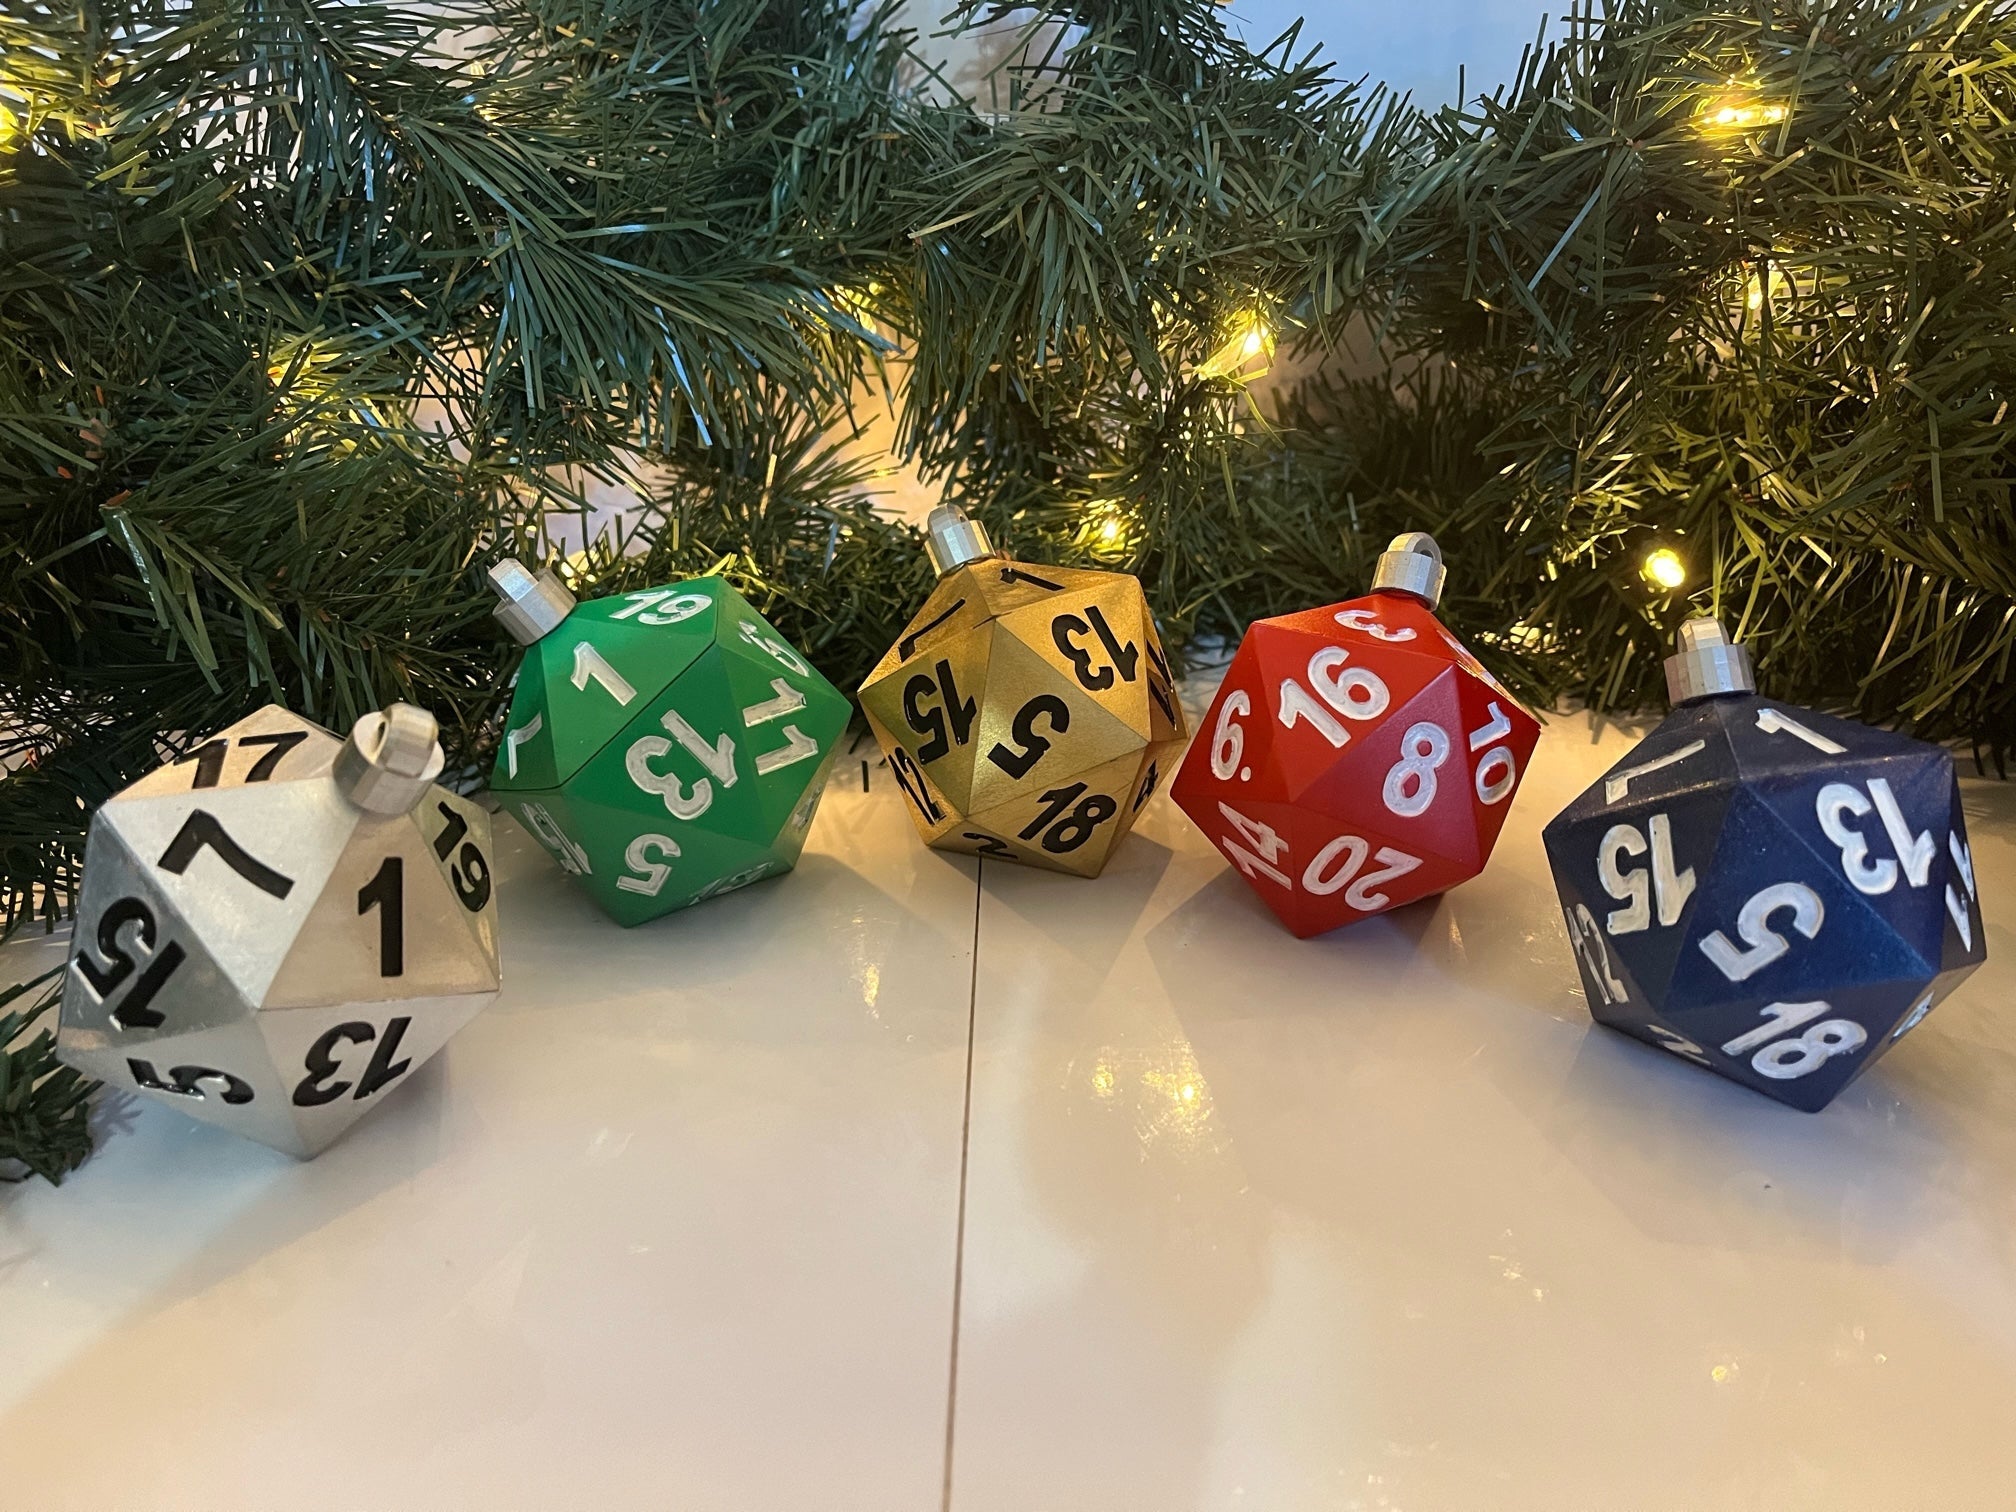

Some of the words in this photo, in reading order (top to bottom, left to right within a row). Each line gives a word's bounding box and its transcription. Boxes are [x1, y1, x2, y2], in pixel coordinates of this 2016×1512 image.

[608, 590, 713, 625] 19
[1000, 567, 1066, 592] 1
[898, 598, 966, 663] 7
[1051, 605, 1139, 691] 13
[1333, 609, 1417, 642] 3
[570, 641, 639, 706] 1
[903, 659, 978, 765] 15
[1277, 646, 1390, 749] 16
[173, 730, 309, 790] 17
[507, 710, 543, 780] 7
[625, 709, 739, 820] 13
[742, 677, 819, 776] 11
[987, 694, 1070, 780] 5
[1382, 721, 1450, 818] 8
[1469, 701, 1515, 805] 10
[1755, 708, 1848, 754] 1
[888, 746, 947, 827] 12
[1605, 740, 1706, 805] 7
[157, 808, 295, 900] 7
[432, 801, 492, 913] 19
[962, 832, 1018, 859] 2
[1017, 781, 1118, 854] 18
[1218, 801, 1292, 891] 14
[1816, 778, 1936, 895] 13
[616, 833, 682, 897] 5
[1302, 835, 1423, 912] 20
[1597, 813, 1697, 935] 15
[357, 856, 404, 978] 1
[1565, 903, 1630, 1005] 12
[1699, 882, 1825, 982] 5
[71, 896, 187, 1032] 15
[126, 1057, 255, 1105] 5
[292, 1016, 412, 1107] 13
[1721, 1000, 1868, 1080] 18
